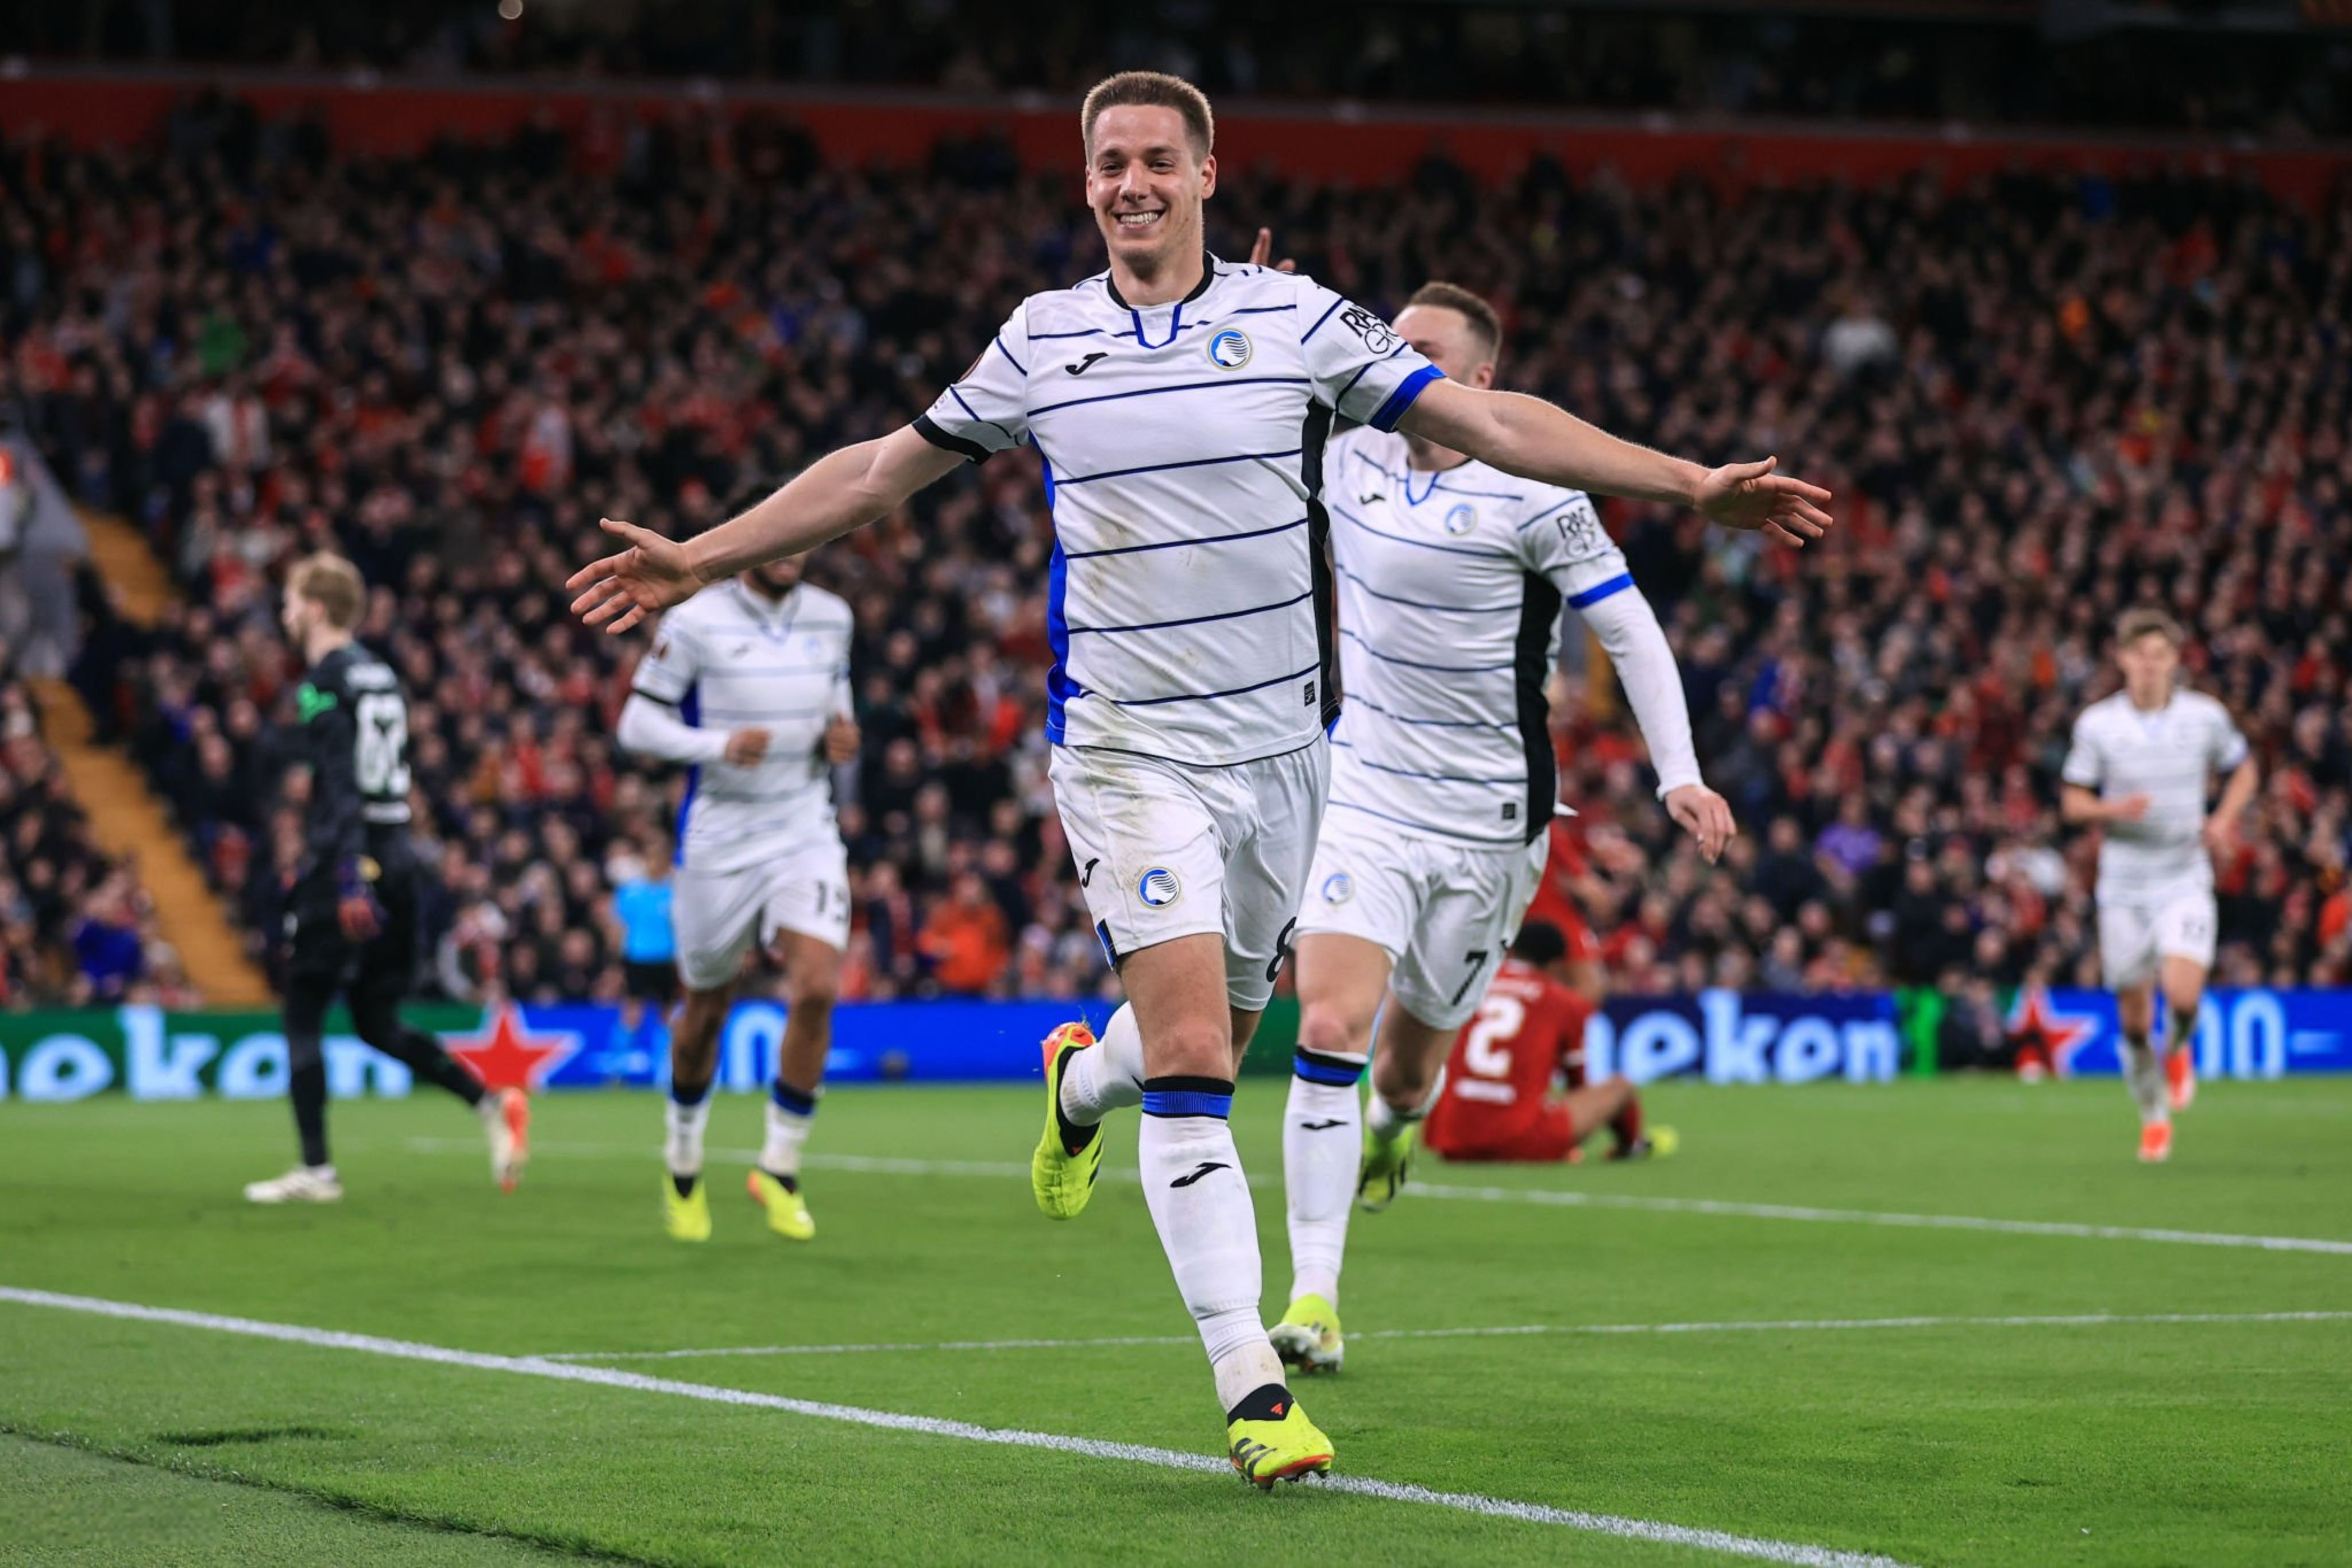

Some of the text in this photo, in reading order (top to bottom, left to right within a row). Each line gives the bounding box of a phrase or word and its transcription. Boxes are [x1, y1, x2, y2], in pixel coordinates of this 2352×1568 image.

[357, 692, 412, 795] 62
[1266, 916, 1297, 983] 8
[1451, 949, 1489, 1007] 7
[0, 1002, 413, 1099] eken
[1465, 995, 1525, 1079] 2
